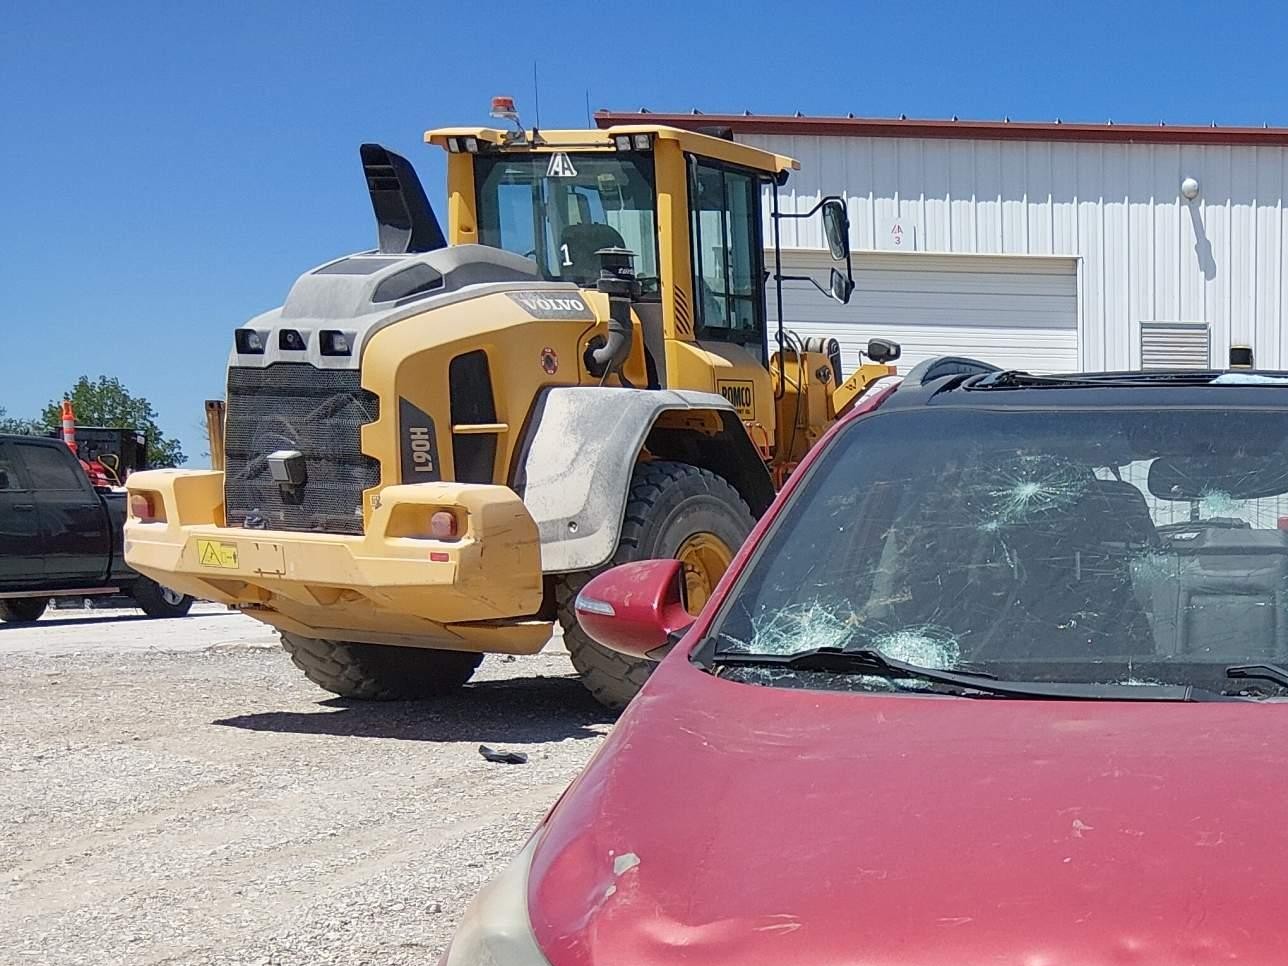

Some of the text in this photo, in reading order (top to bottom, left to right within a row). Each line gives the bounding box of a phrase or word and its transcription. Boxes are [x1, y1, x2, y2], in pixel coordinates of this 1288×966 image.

[895, 236, 902, 246] 3
[560, 243, 573, 266] 1
[523, 298, 585, 312] VOLVO
[409, 427, 433, 472] L90H
